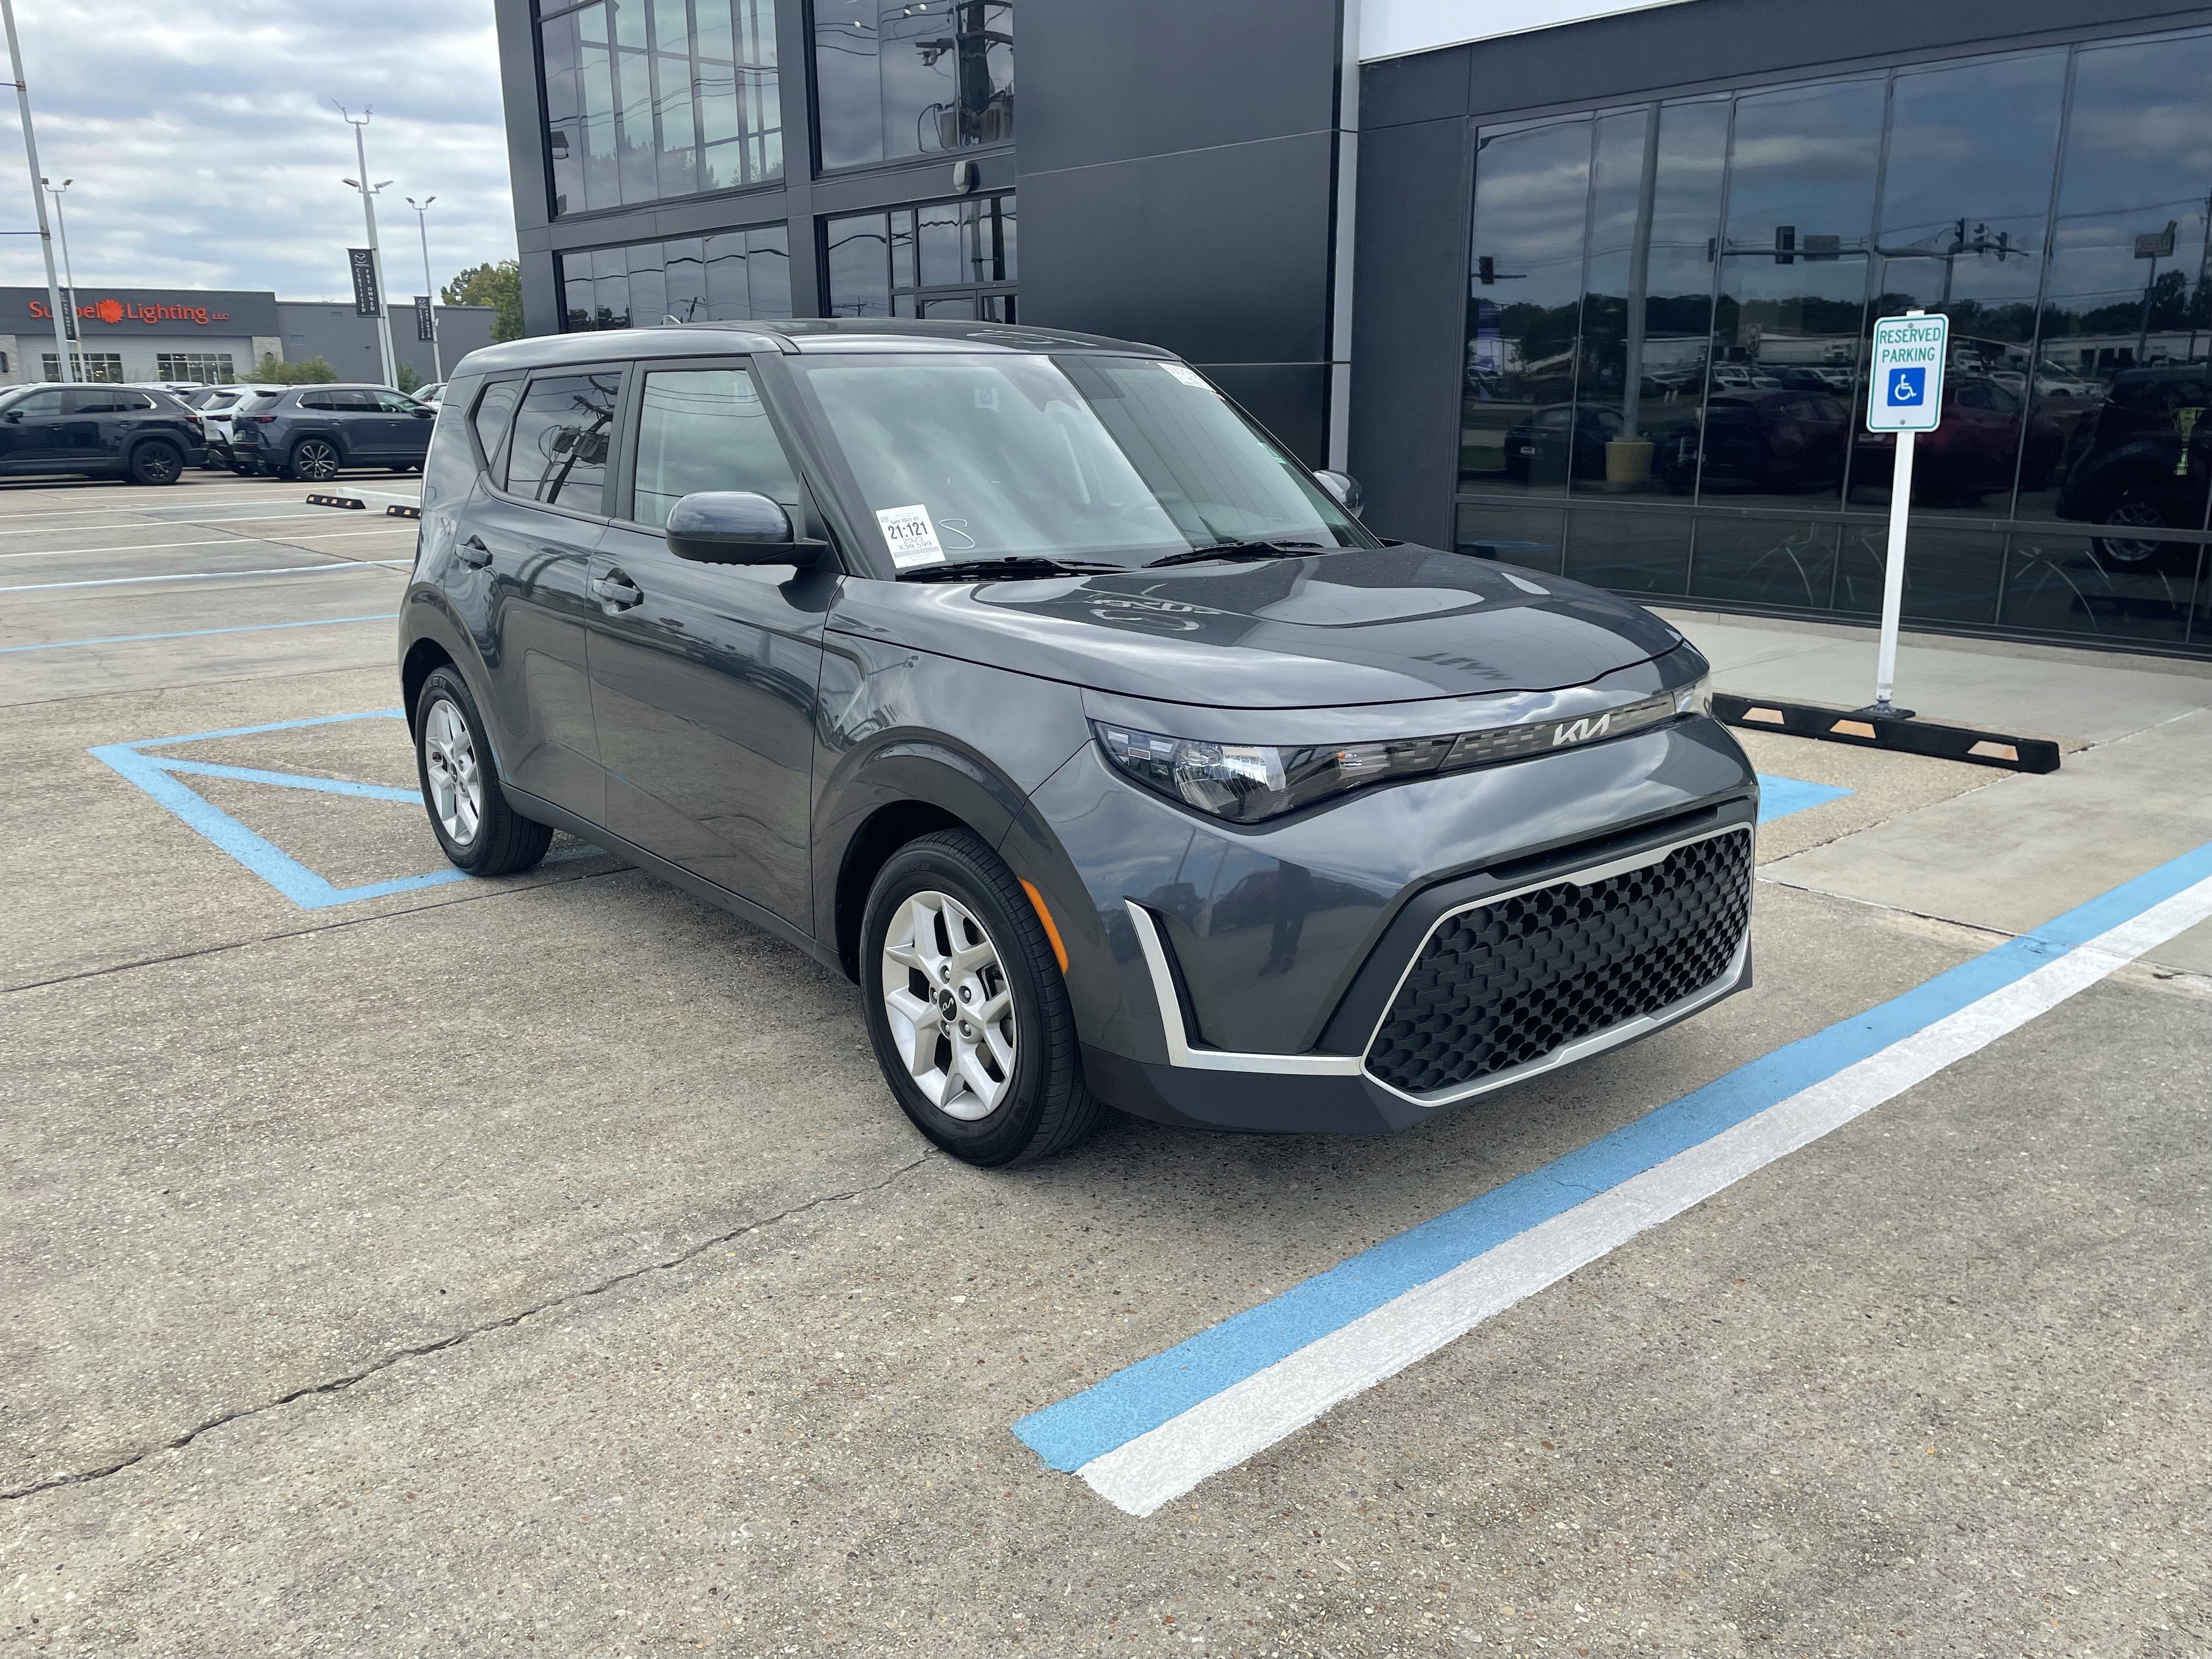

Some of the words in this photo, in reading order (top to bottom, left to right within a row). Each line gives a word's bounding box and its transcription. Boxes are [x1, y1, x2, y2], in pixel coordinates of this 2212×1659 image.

[126, 302, 209, 324] Lighting
[1880, 327, 1941, 344] RESERVED
[1882, 347, 1936, 363] PARKING
[888, 521, 928, 540] 21:121
[903, 536, 923, 544] 2023
[1552, 713, 1611, 746] KIA
